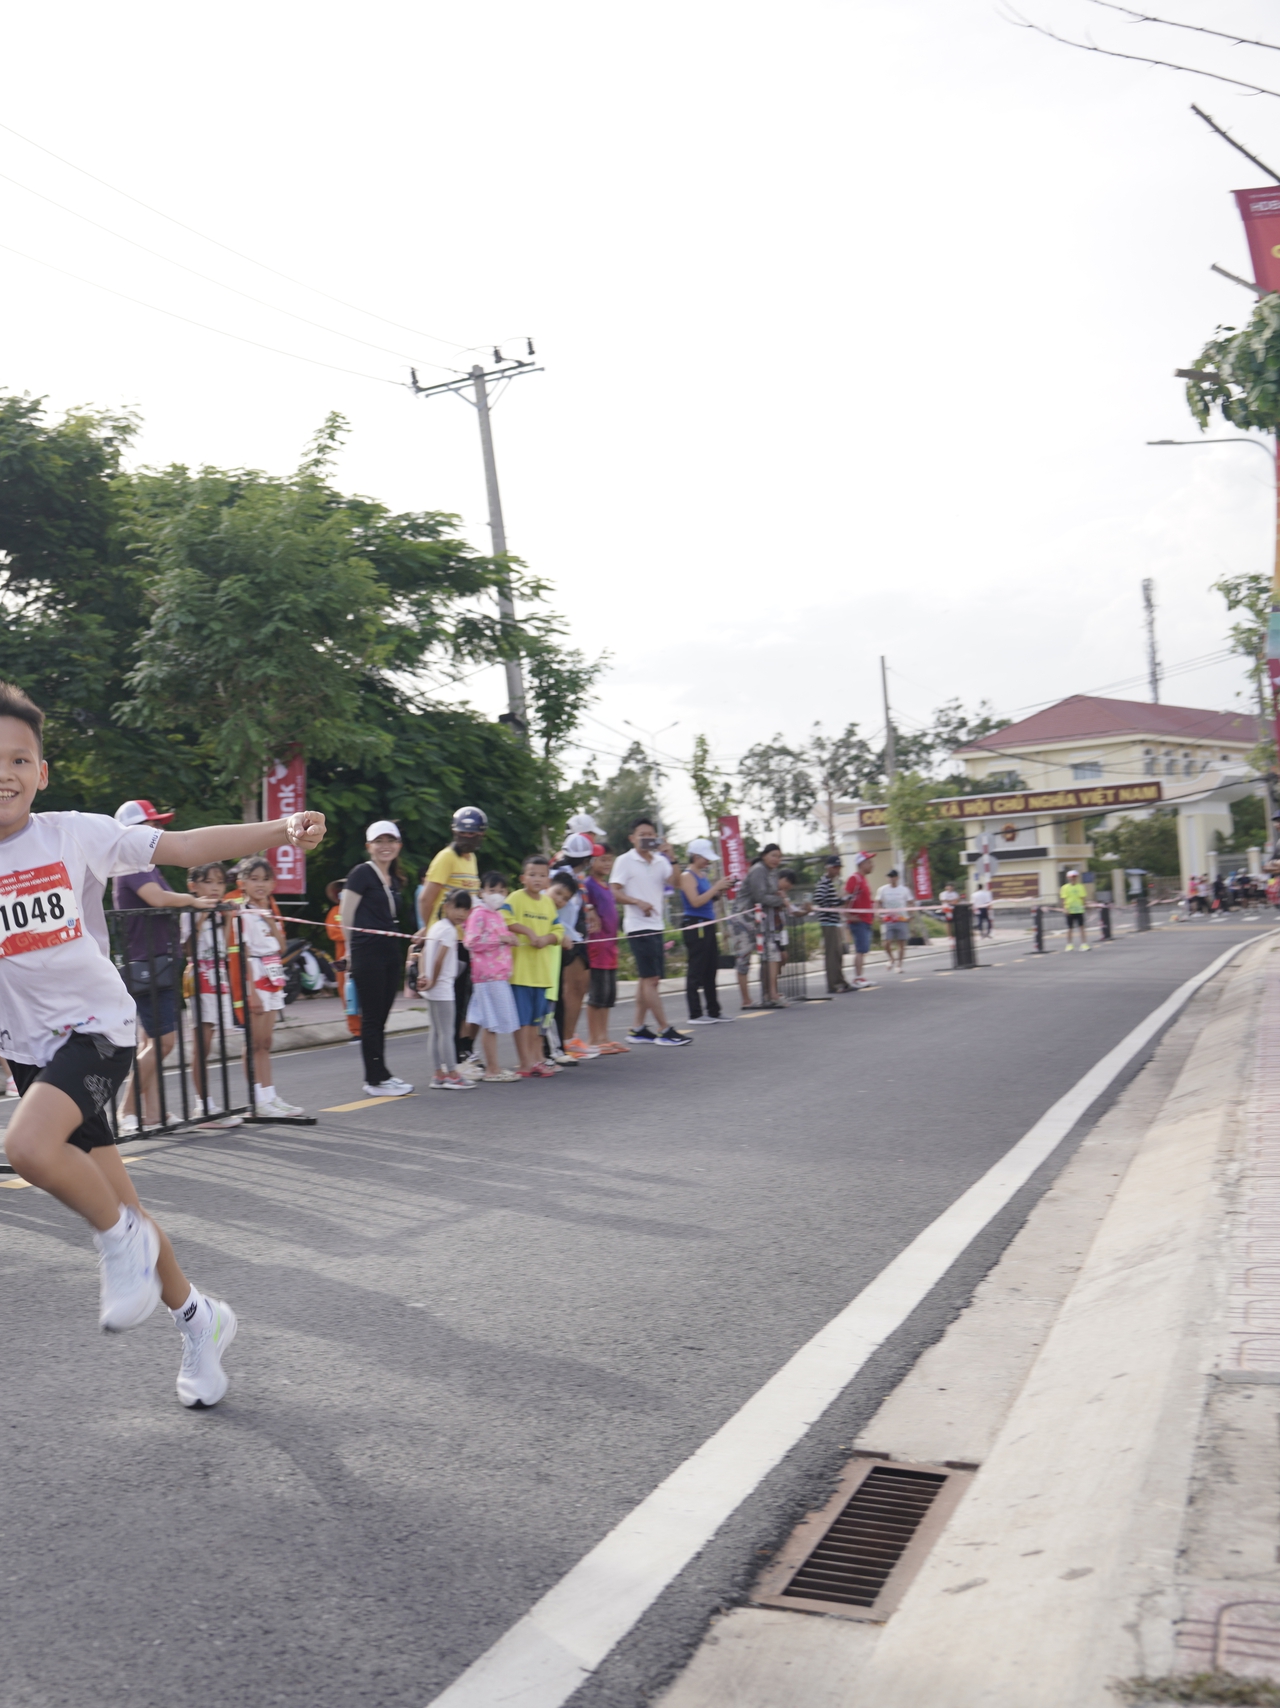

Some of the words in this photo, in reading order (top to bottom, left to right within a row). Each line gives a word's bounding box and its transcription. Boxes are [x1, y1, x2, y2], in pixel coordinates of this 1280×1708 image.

[963, 798, 991, 816] HỘI
[993, 793, 1026, 813] CHỦ
[1028, 790, 1078, 810] NGHĨA
[1078, 787, 1117, 806] VIỆT
[1118, 785, 1159, 801] NAM
